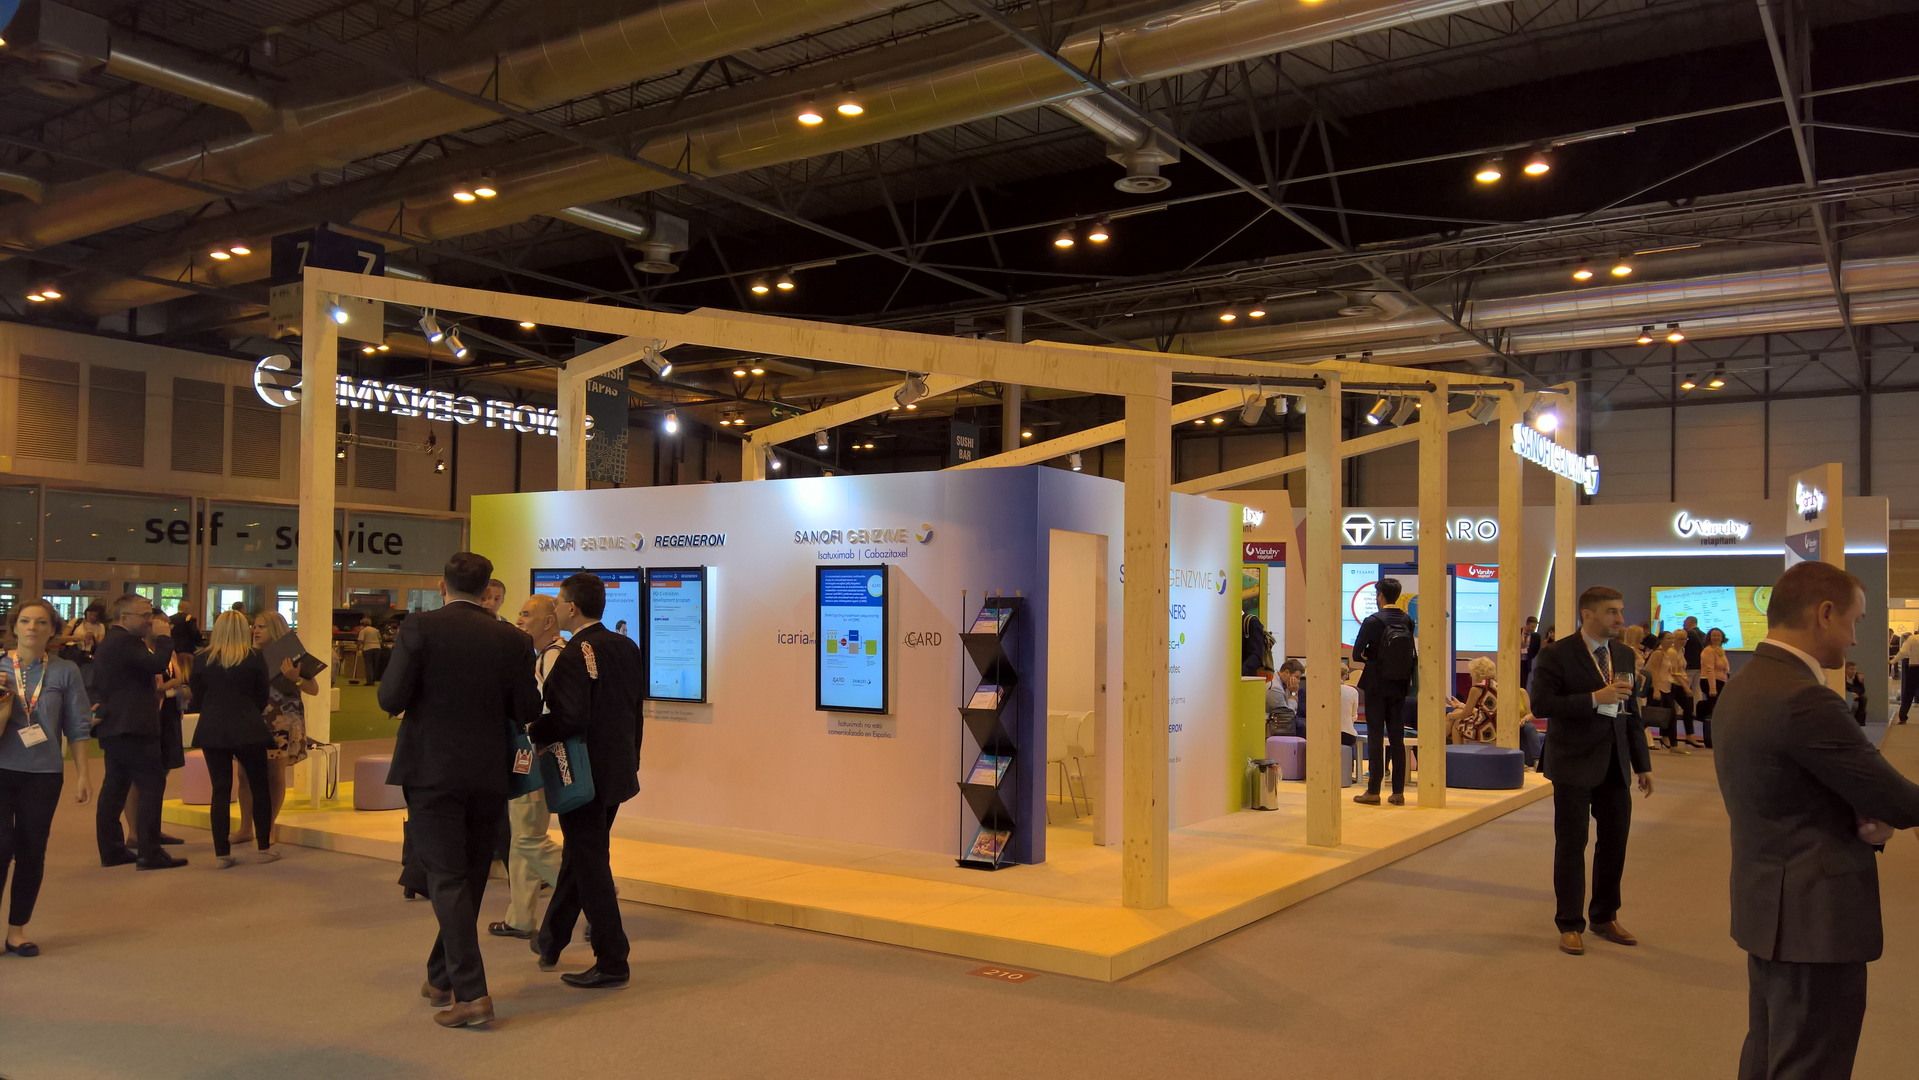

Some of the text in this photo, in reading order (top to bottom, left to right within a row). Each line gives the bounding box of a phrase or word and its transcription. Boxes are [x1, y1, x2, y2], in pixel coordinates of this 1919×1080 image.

[357, 249, 377, 275] 7
[956, 435, 974, 449] SUSHI
[958, 448, 972, 461] BAR
[144, 510, 224, 547] self
[275, 522, 404, 556] svice
[794, 528, 909, 545] SANOFI GENZYME
[1378, 520, 1497, 540] TERO
[538, 533, 727, 552] SANOFI GENZYME REGENERON
[817, 550, 855, 561] Isatuximab
[864, 547, 909, 559] Cabazitaxel
[1254, 546, 1281, 558] Varuby
[777, 629, 810, 645] icaria
[983, 969, 1024, 980] 210
